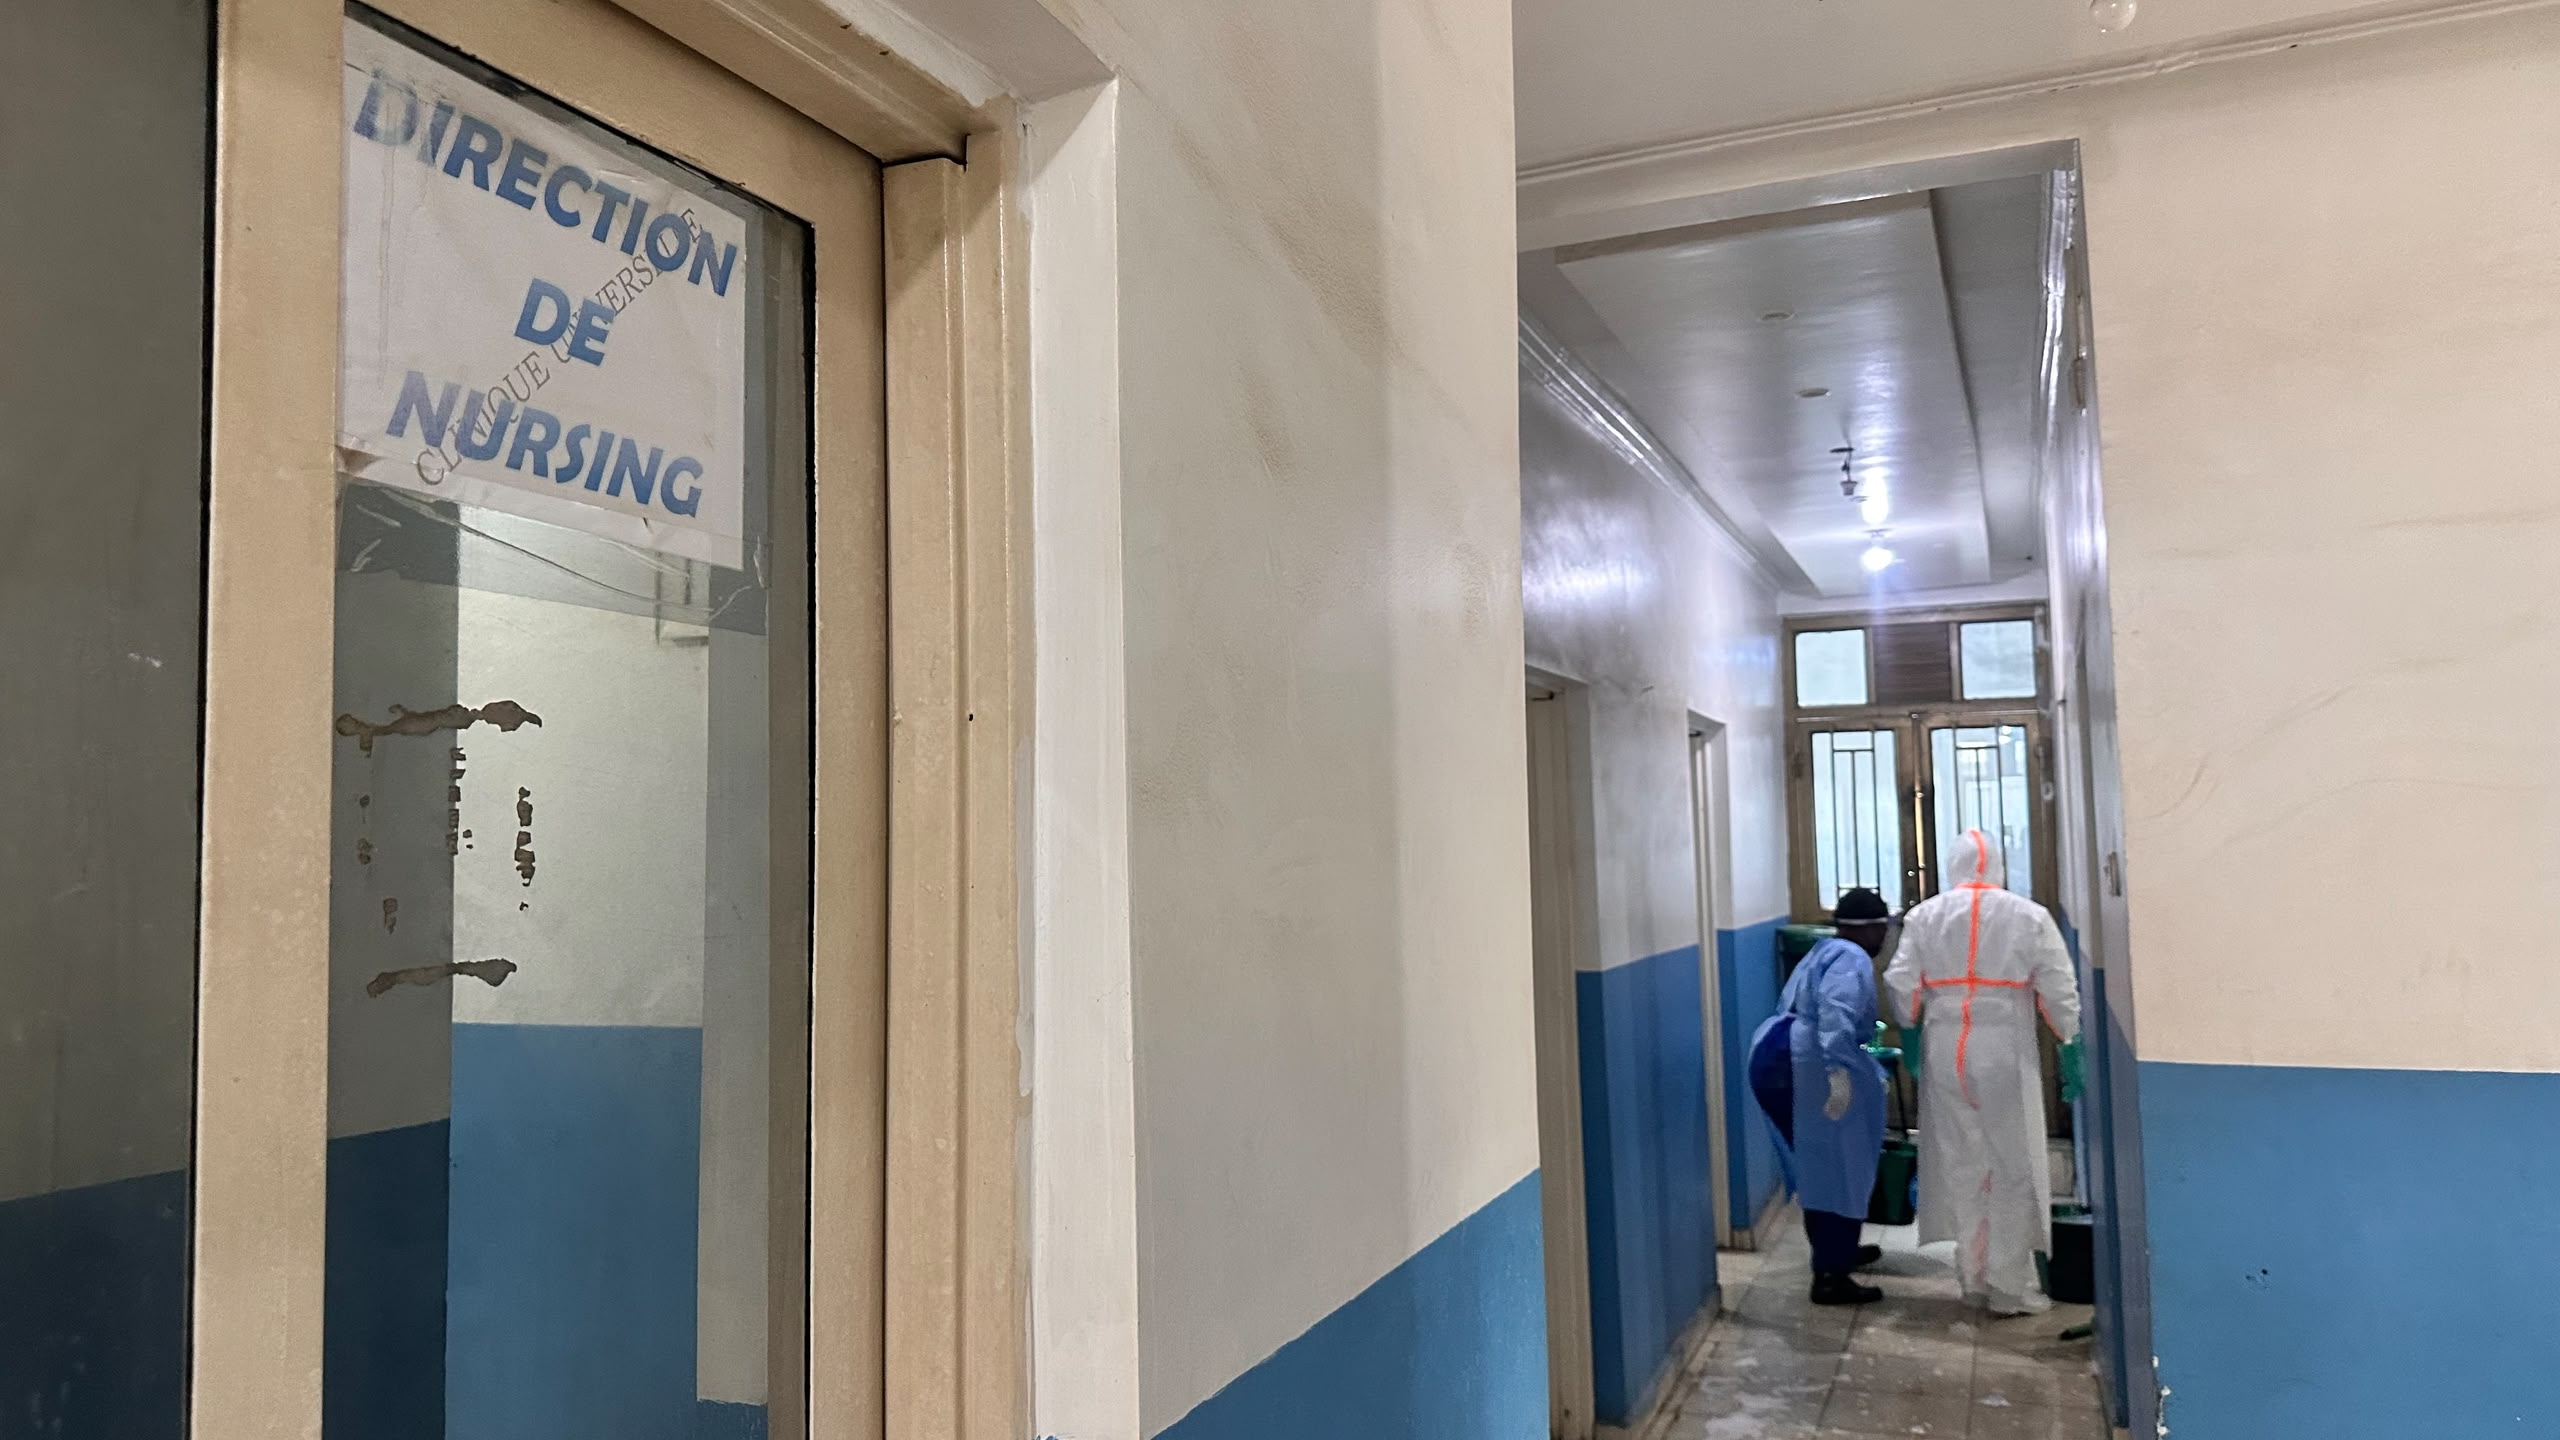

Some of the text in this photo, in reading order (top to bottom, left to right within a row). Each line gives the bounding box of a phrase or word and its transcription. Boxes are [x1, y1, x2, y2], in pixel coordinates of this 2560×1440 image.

[353, 67, 737, 297] DIRECTION
[514, 278, 617, 366] DE
[385, 370, 704, 518] NURSING
[416, 351, 551, 486] CLIQUE
